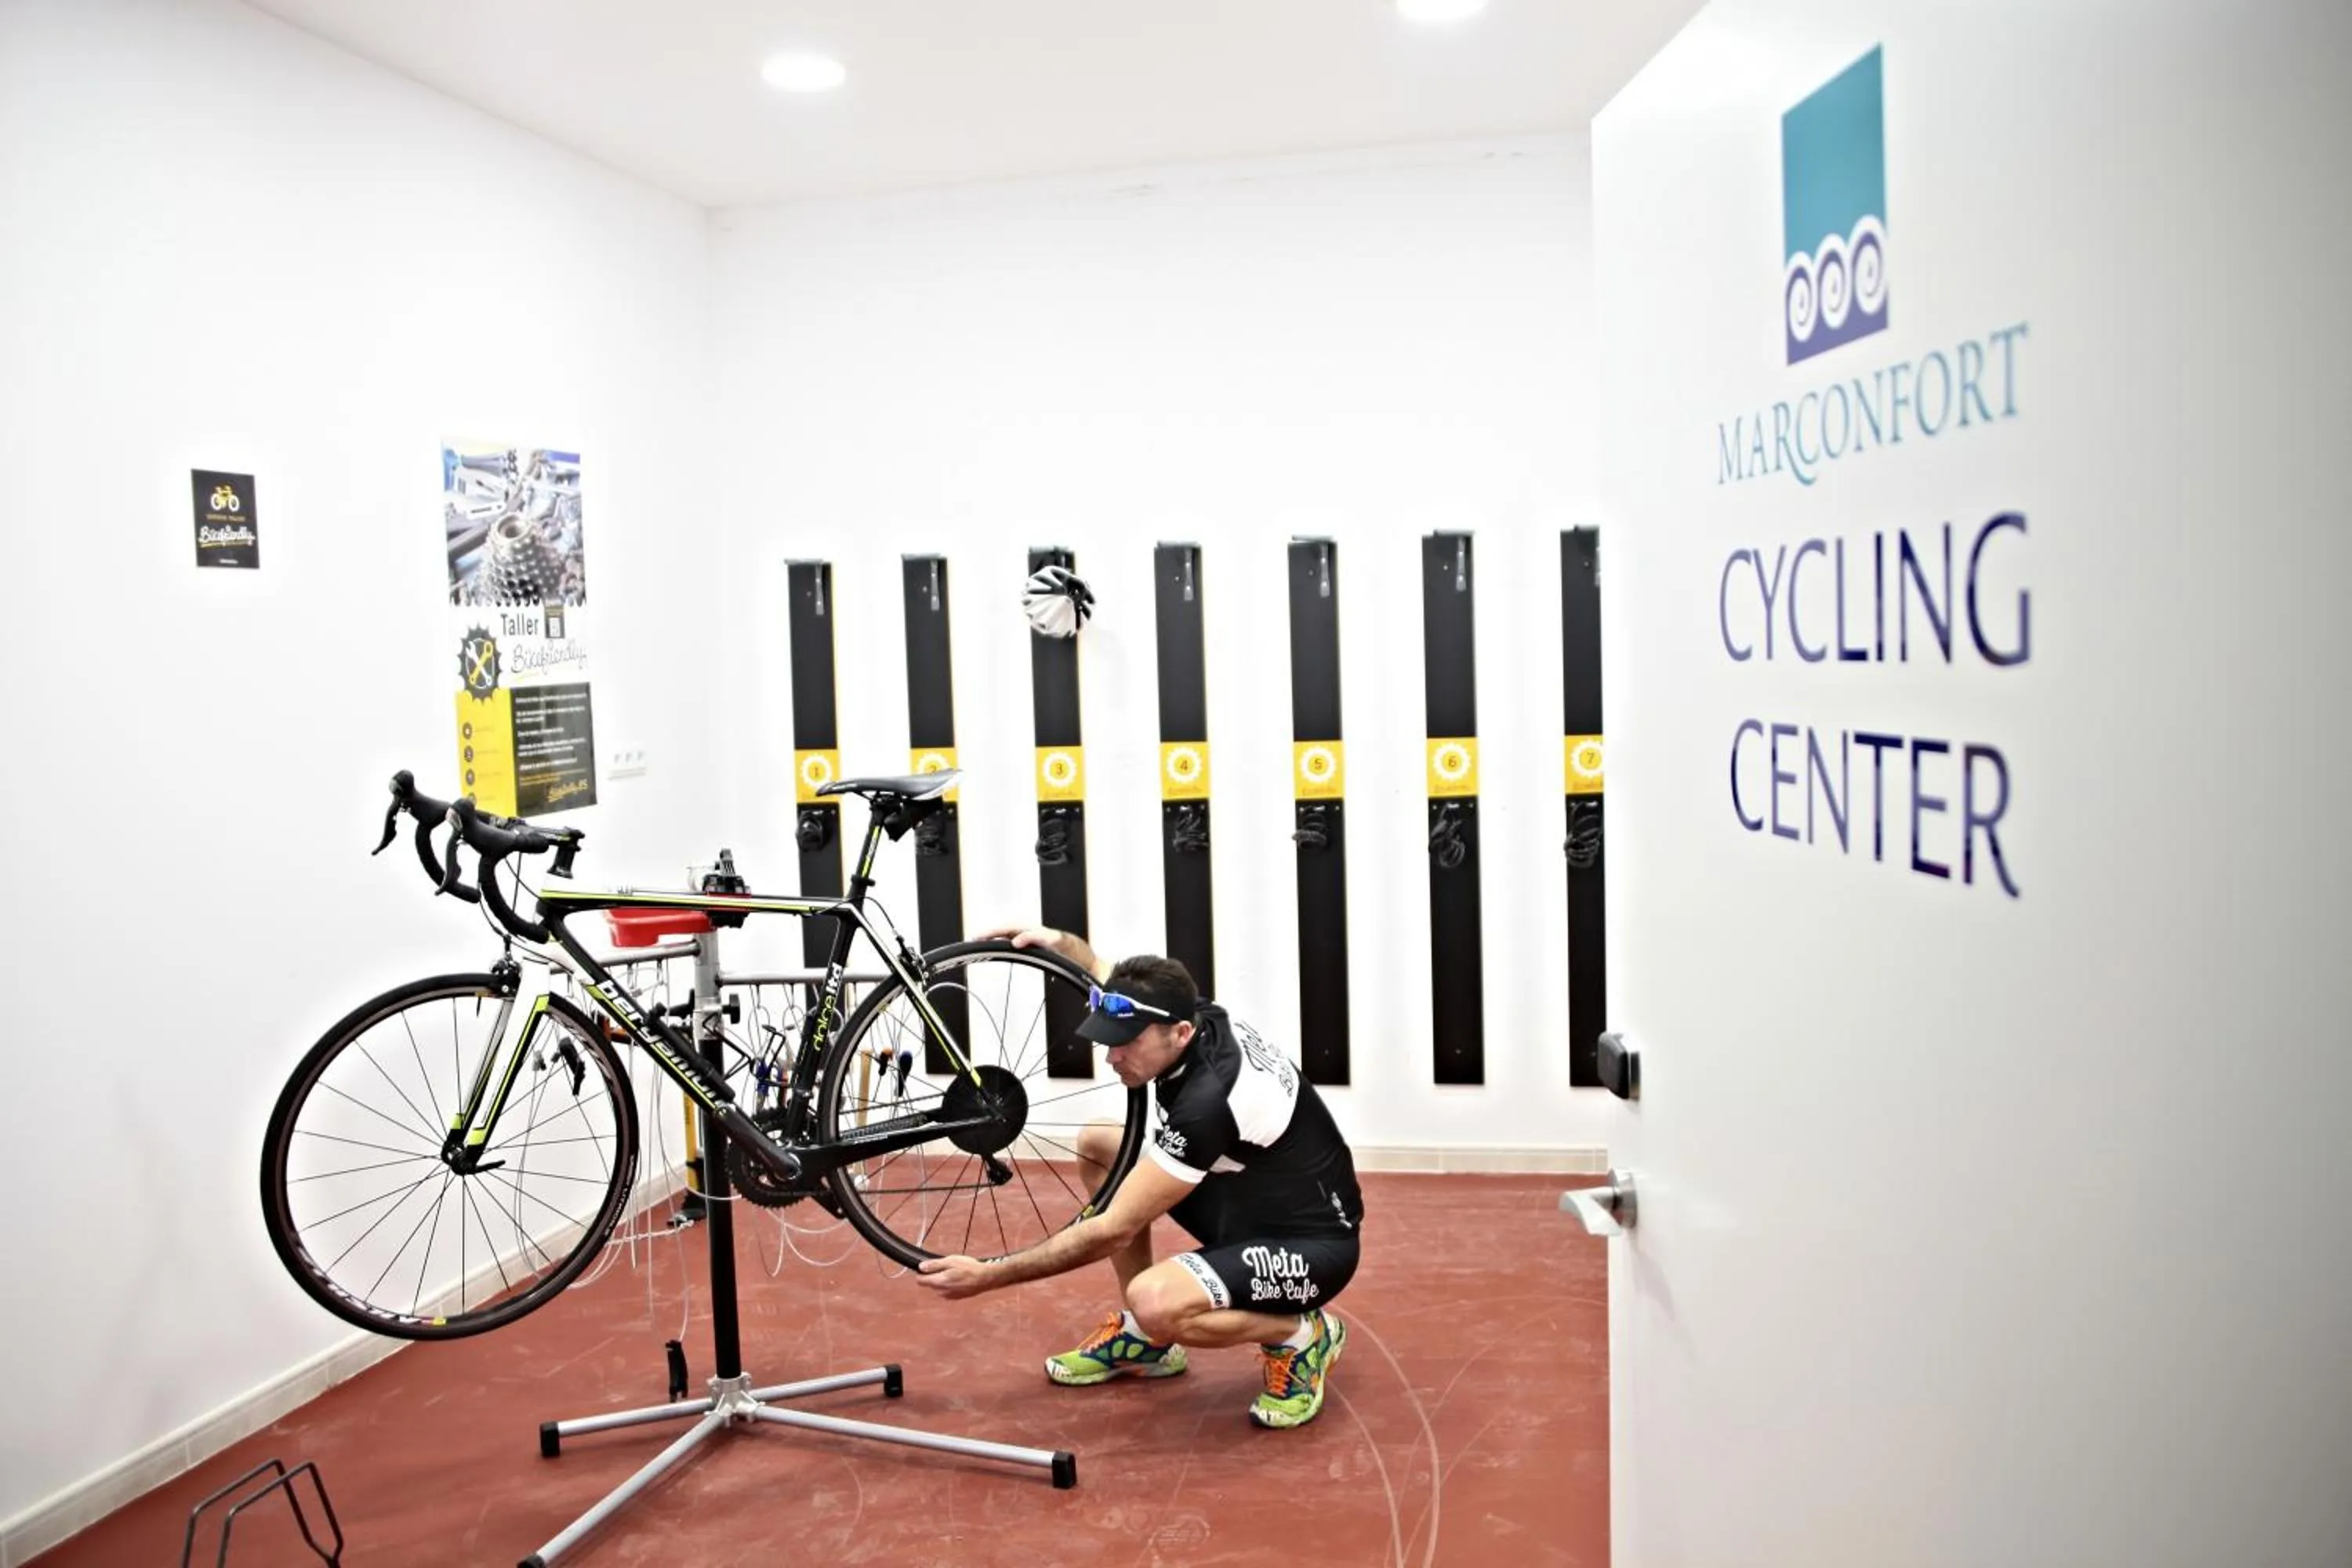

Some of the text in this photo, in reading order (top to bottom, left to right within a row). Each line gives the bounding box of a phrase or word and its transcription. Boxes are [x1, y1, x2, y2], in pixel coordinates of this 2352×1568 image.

[1718, 321, 2029, 486] MARCONFORT
[1719, 510, 2031, 666] CYCLING
[500, 612, 539, 636] Taller
[1056, 763, 1064, 775] 3
[1178, 760, 1188, 771] 4
[1314, 757, 1323, 771] 5
[1448, 755, 1457, 768] 6
[1586, 752, 1595, 764] 7
[1730, 718, 2020, 898] CENTER
[1241, 1245, 1309, 1284] Meta
[1250, 1277, 1319, 1305] Bike Cafe
